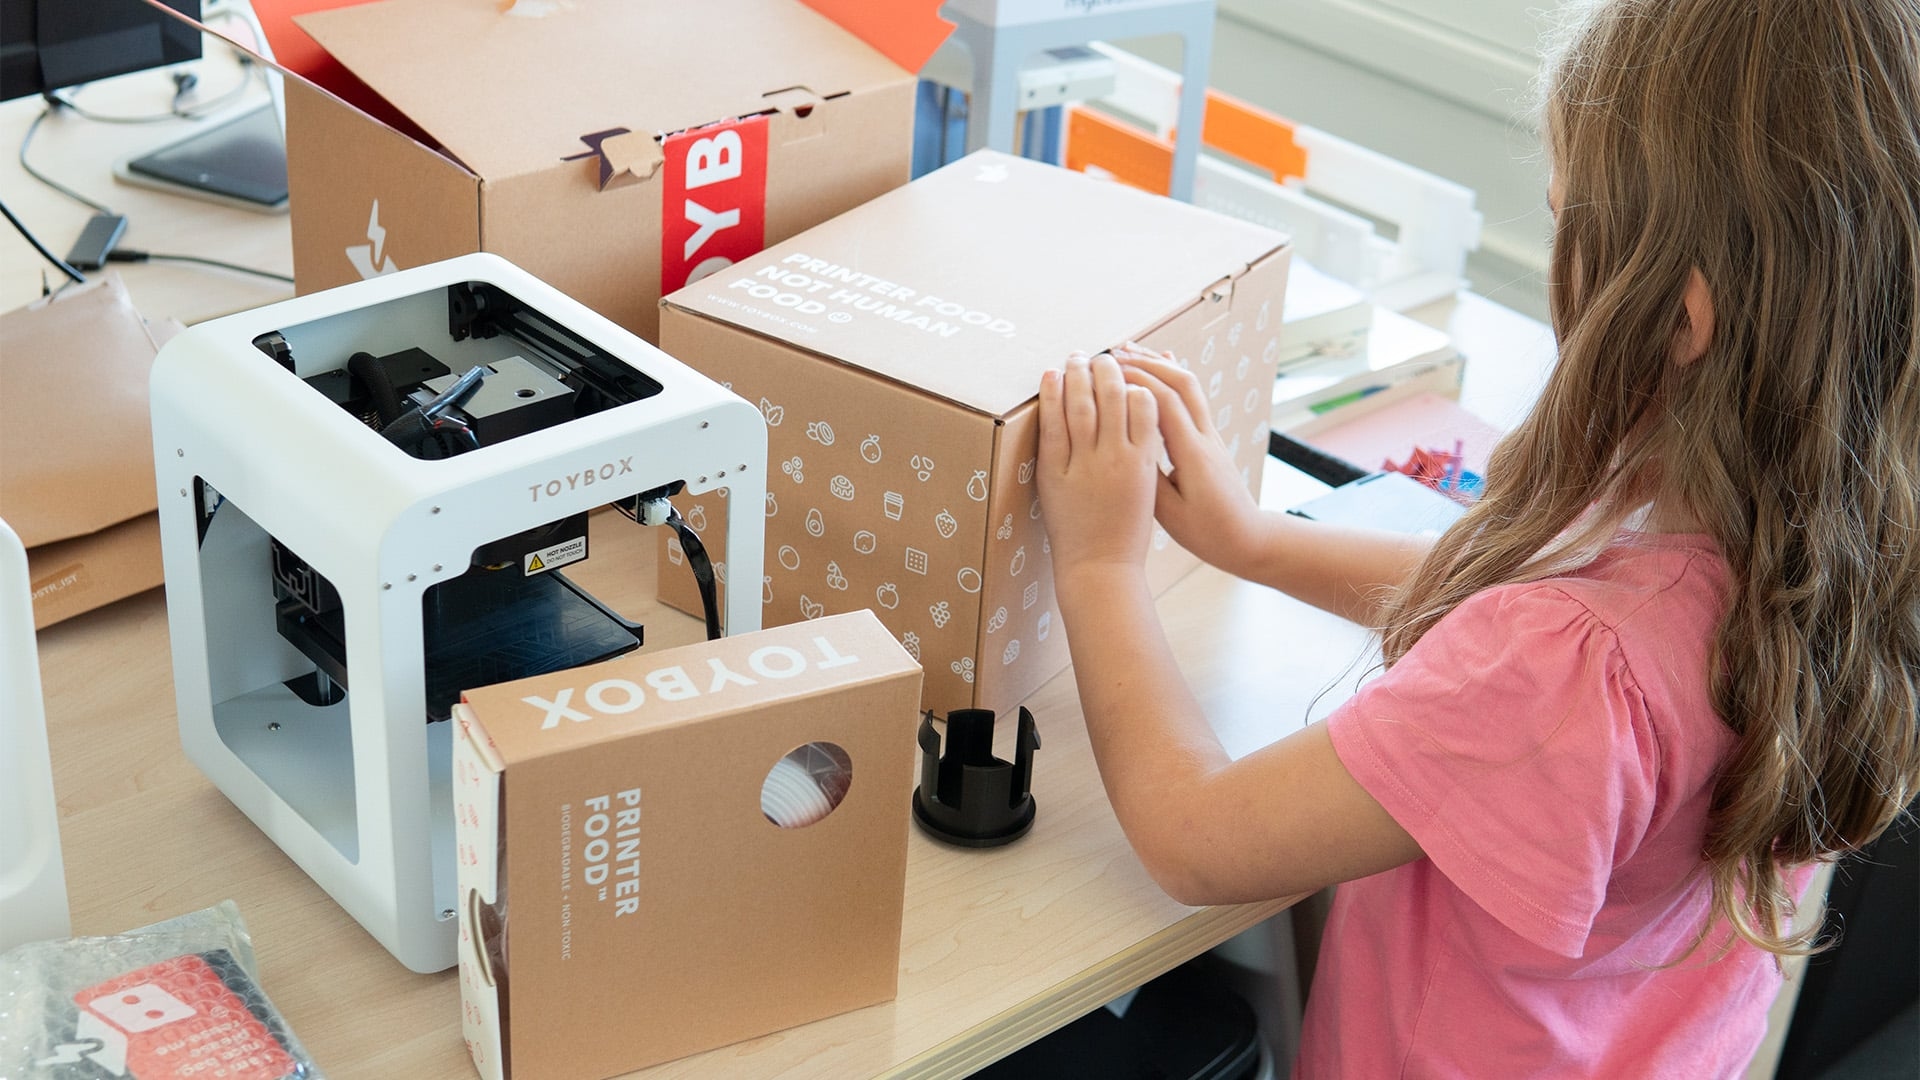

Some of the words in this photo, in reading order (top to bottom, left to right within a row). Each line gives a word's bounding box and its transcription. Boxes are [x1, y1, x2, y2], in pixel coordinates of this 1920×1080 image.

[727, 277, 827, 314] FOOD
[755, 265, 834, 293] NOT
[827, 288, 962, 338] HUMAN
[781, 252, 917, 302] PRINTER
[914, 295, 1017, 338] FOOD,
[528, 455, 634, 503] TOYBOX
[546, 549, 559, 558] HOT
[560, 541, 582, 553] NOZZLE
[566, 549, 583, 558] TOUCH
[520, 636, 860, 731] TOYBOX
[561, 803, 572, 891] BIODEGRADABLE
[615, 787, 641, 918] PRINTER
[561, 903, 572, 961] NON-TOXIC
[155, 1039, 186, 1056] me
[188, 1020, 240, 1042] reuse
[190, 1028, 250, 1058] please
[222, 1041, 261, 1061] nice
[231, 1056, 260, 1073] am
[214, 1068, 226, 1078] a
